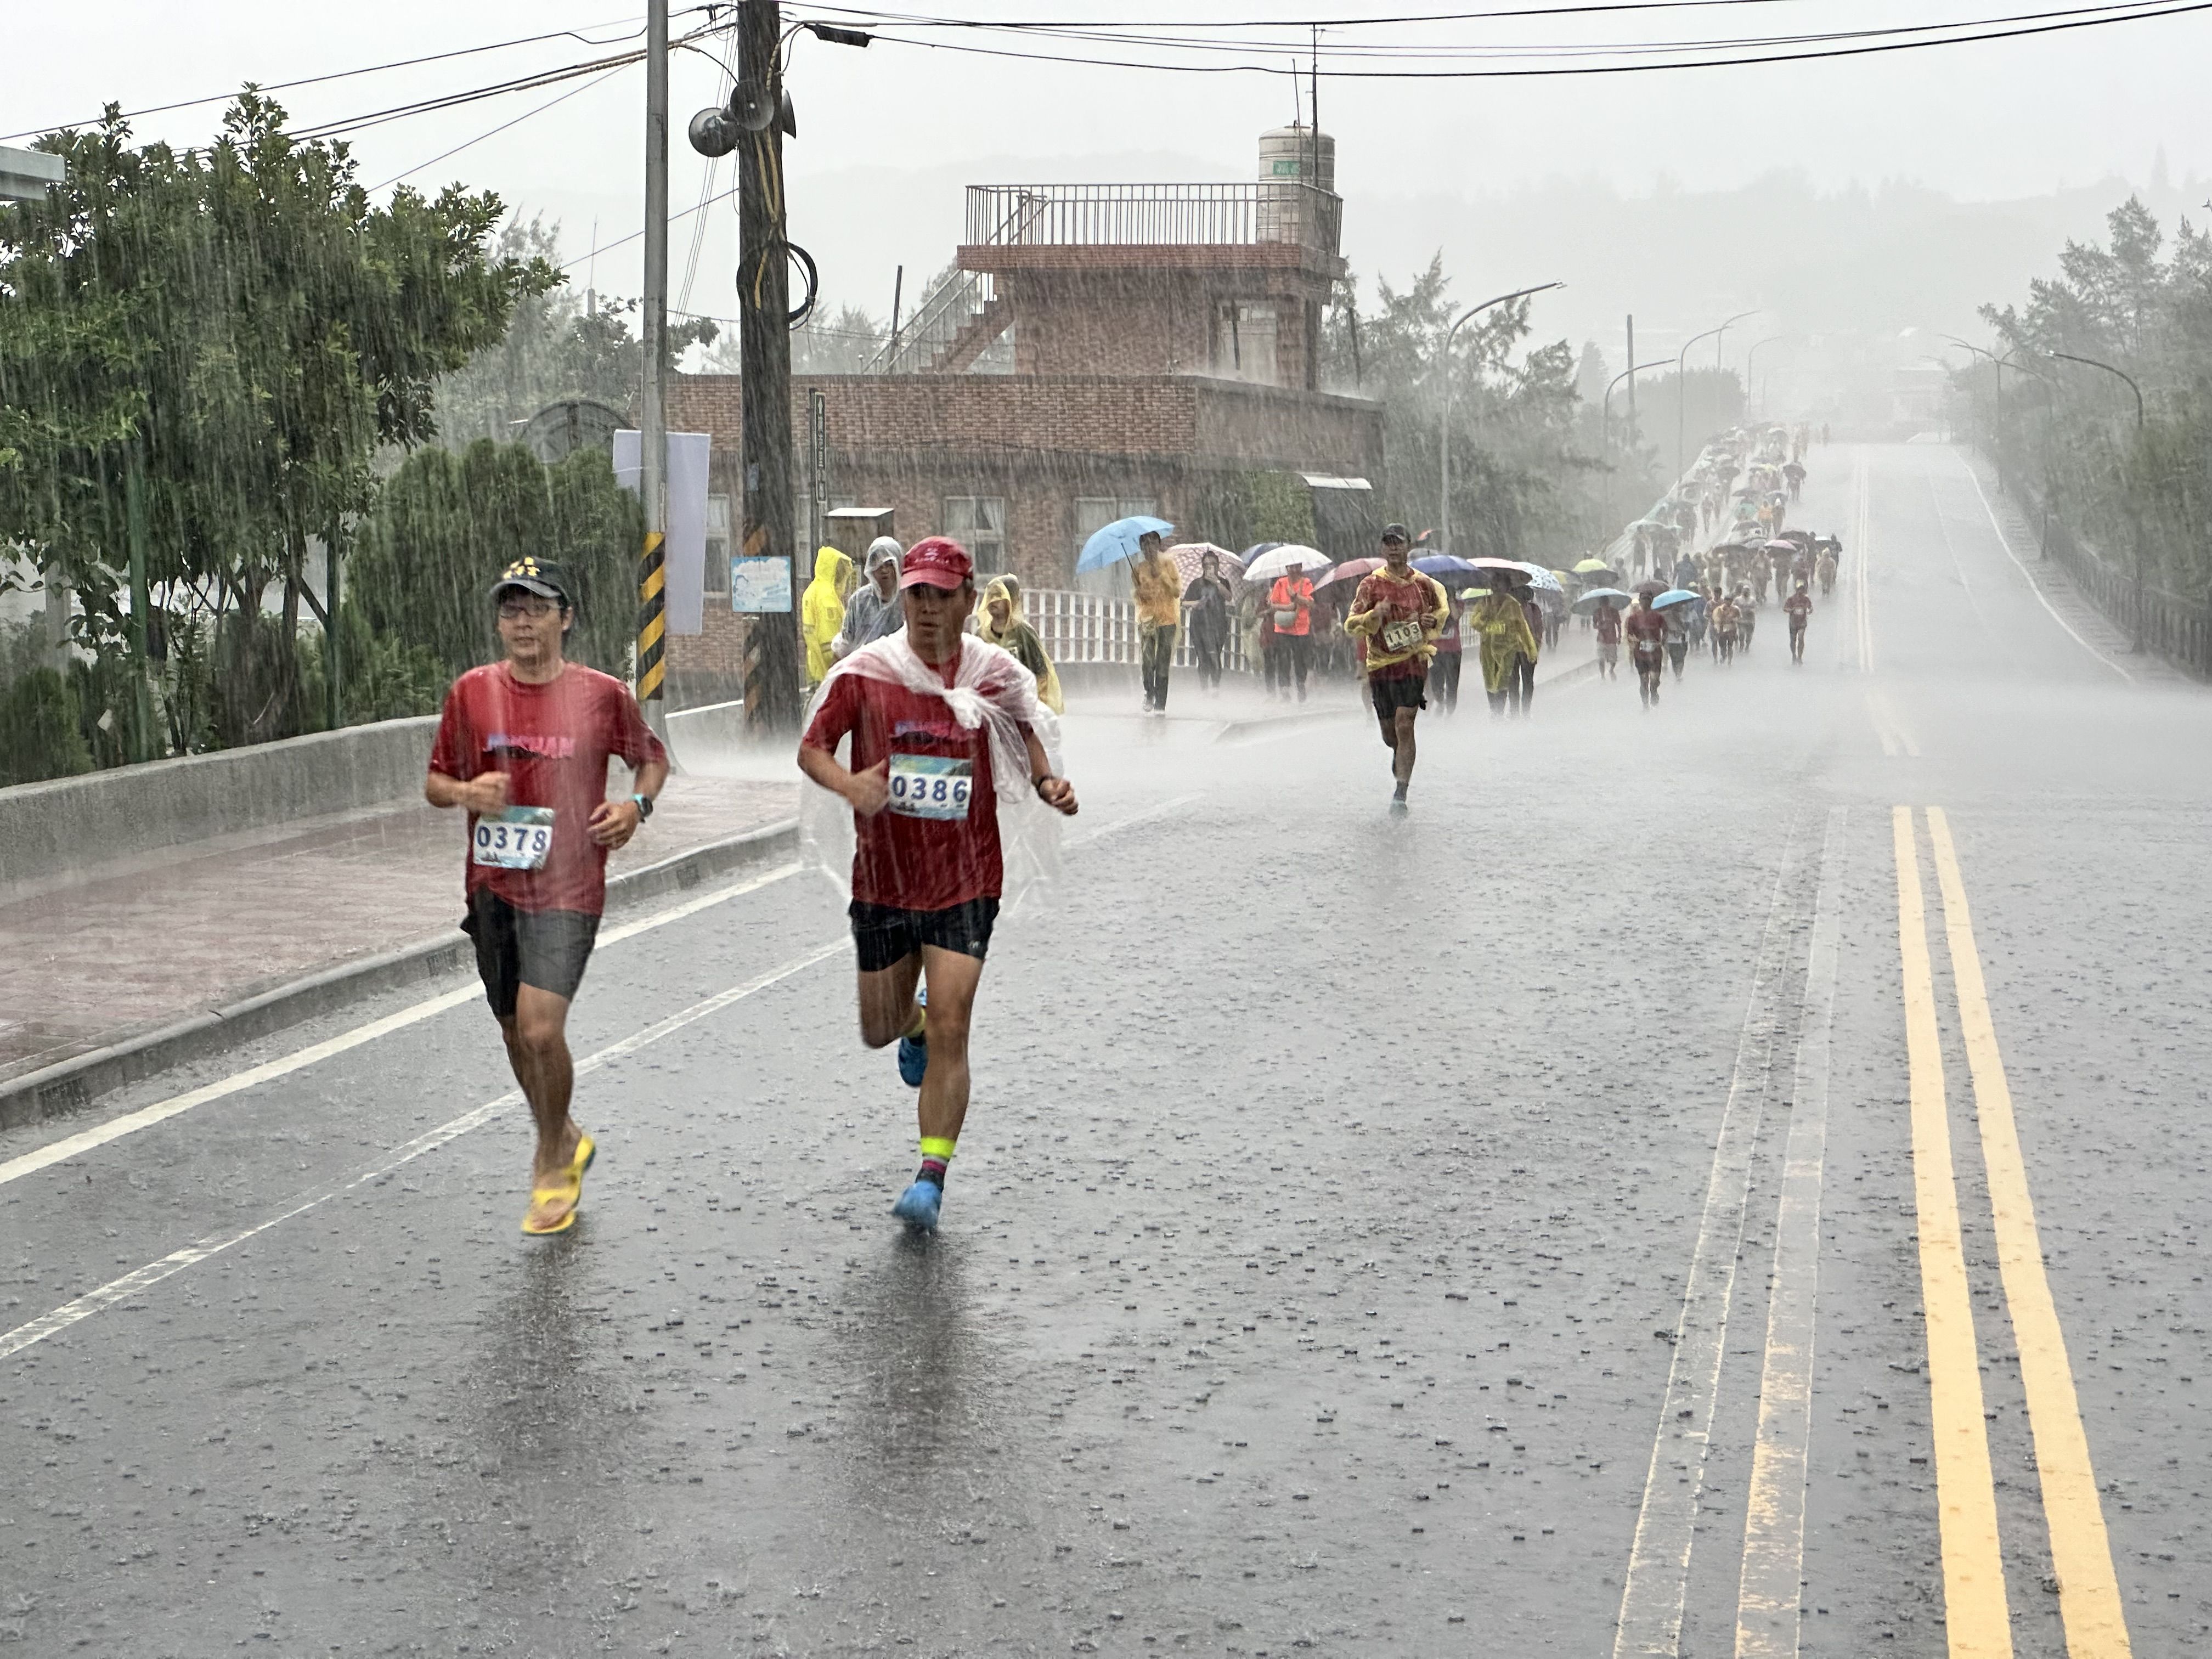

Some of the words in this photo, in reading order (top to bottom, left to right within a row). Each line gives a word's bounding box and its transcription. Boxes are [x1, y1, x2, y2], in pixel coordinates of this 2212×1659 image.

[1386, 624, 1419, 643] 1103
[892, 776, 968, 802] 0386
[477, 826, 548, 851] 0378
